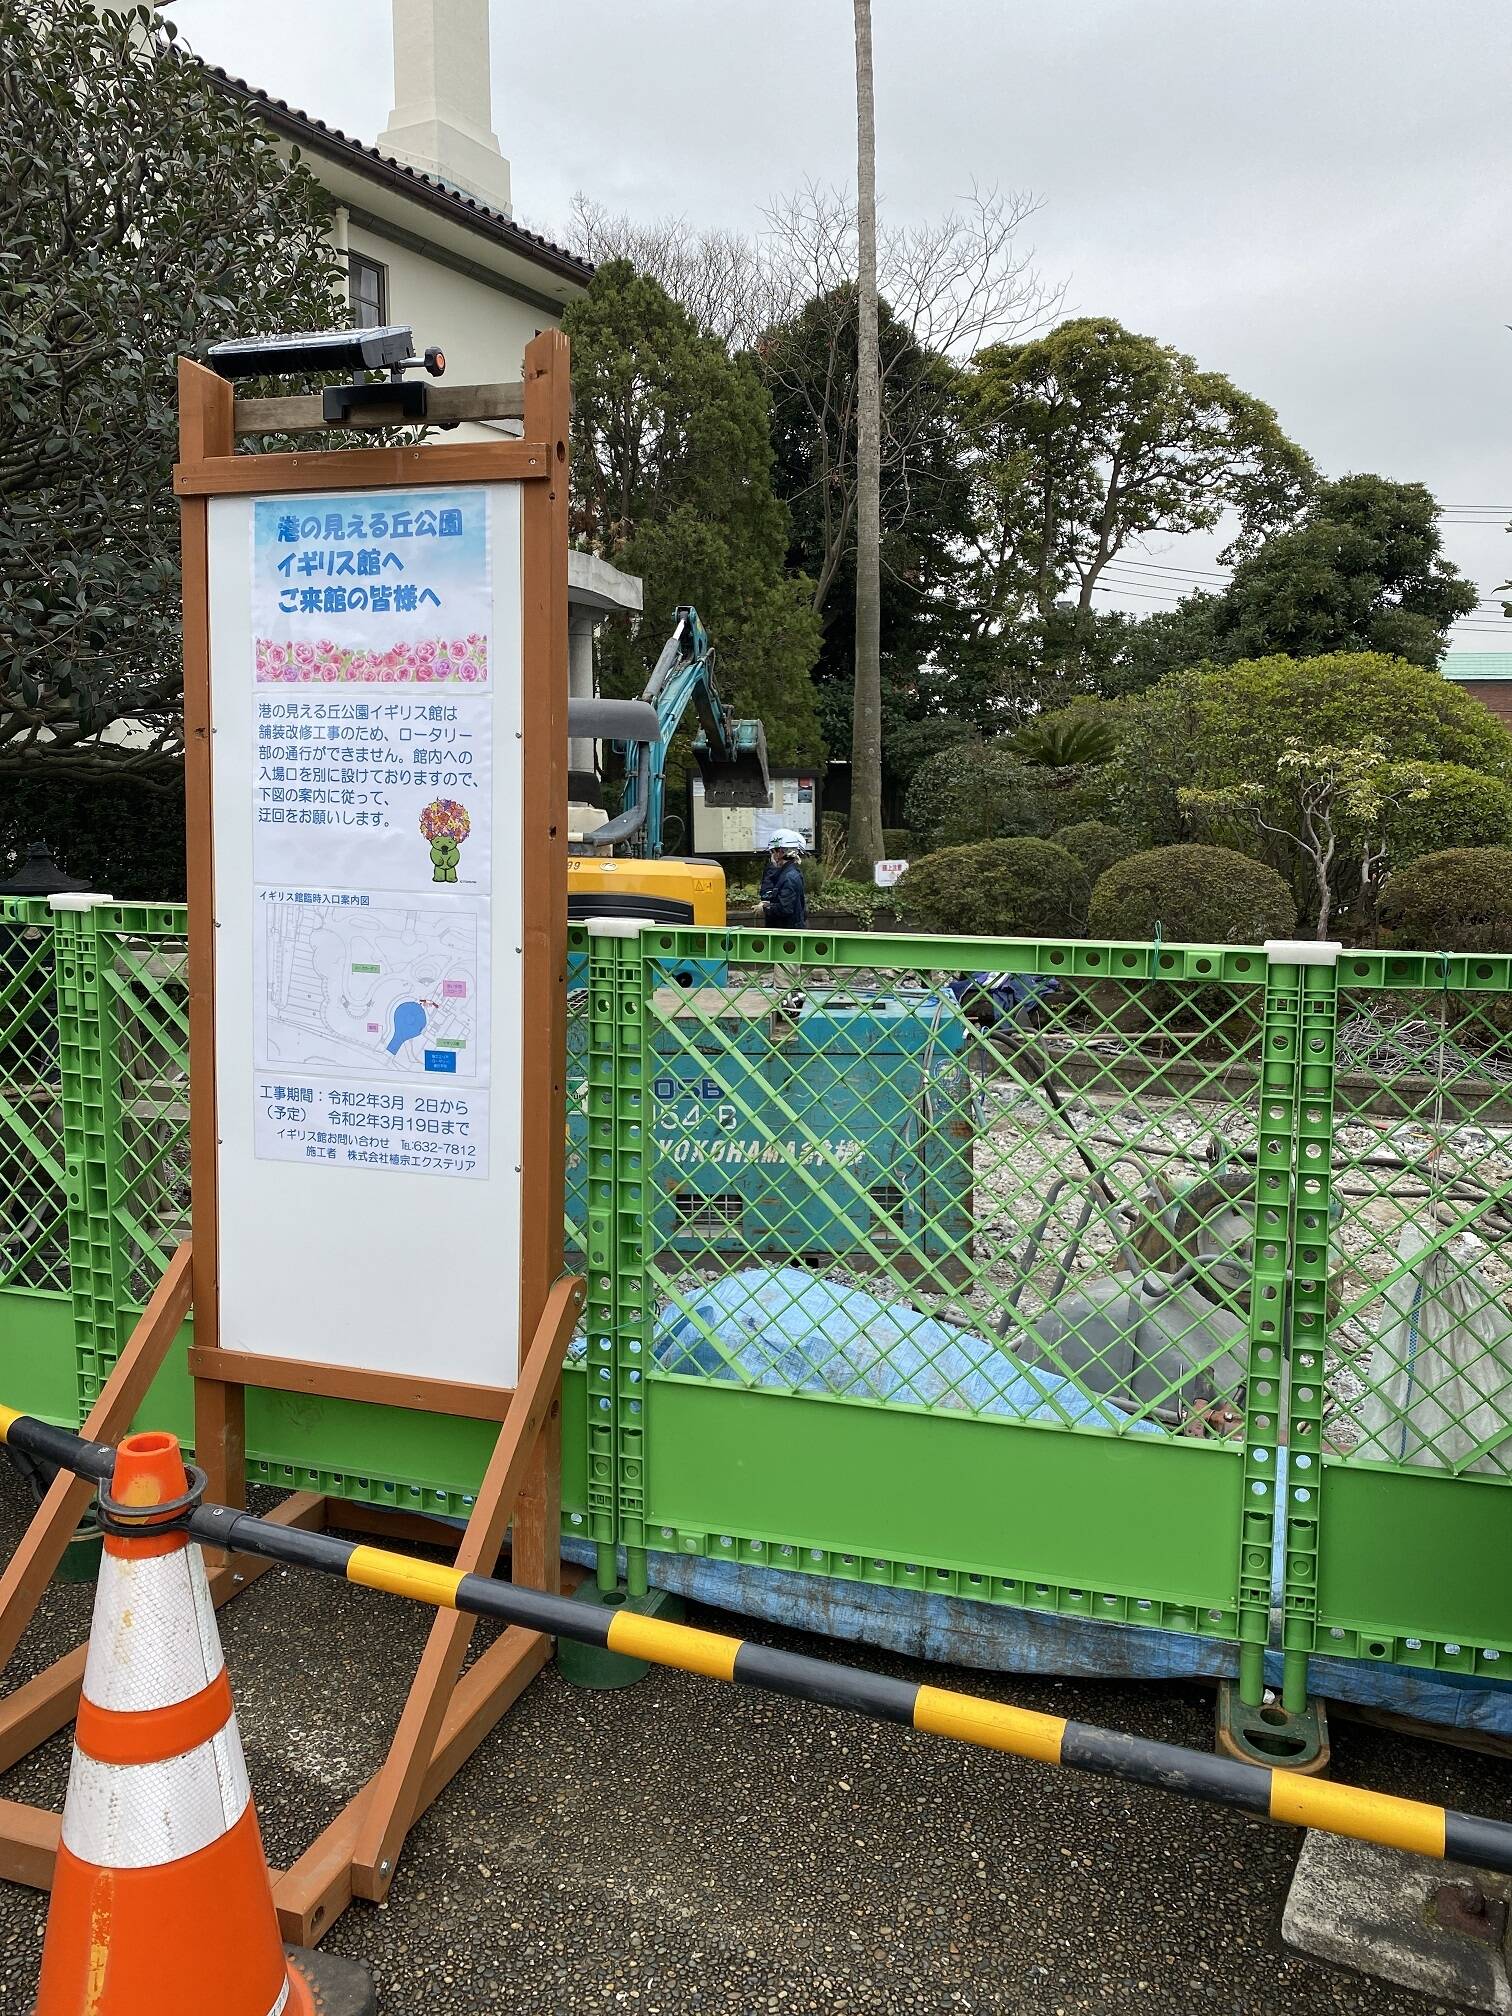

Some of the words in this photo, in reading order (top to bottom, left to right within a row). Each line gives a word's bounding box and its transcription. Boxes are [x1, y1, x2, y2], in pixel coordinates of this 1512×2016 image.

[277, 508, 463, 543] 港の見える丘公園
[277, 548, 405, 577] イギリス館へ
[278, 584, 442, 613] ご来館の皆様へ
[258, 703, 458, 721] 港の見える丘公園イギリス館は
[258, 724, 473, 743] 舗装改修工事のため、ロータリー
[258, 745, 473, 765] 部の通行ができません。館内への
[258, 766, 479, 788] 入場口を別に設けておりますので、
[258, 786, 390, 806] 下図の案内に従って、
[258, 808, 392, 828] 迂回をお願いします。
[259, 890, 370, 906] イギリス館臨時入口案内図
[327, 1110, 470, 1136] 令和2年3月19日まで
[276, 1128, 391, 1149] イギリス館お問い合わせ
[306, 1145, 337, 1159] 施工者
[347, 1149, 476, 1172] 株式会社植宗エクステリア
